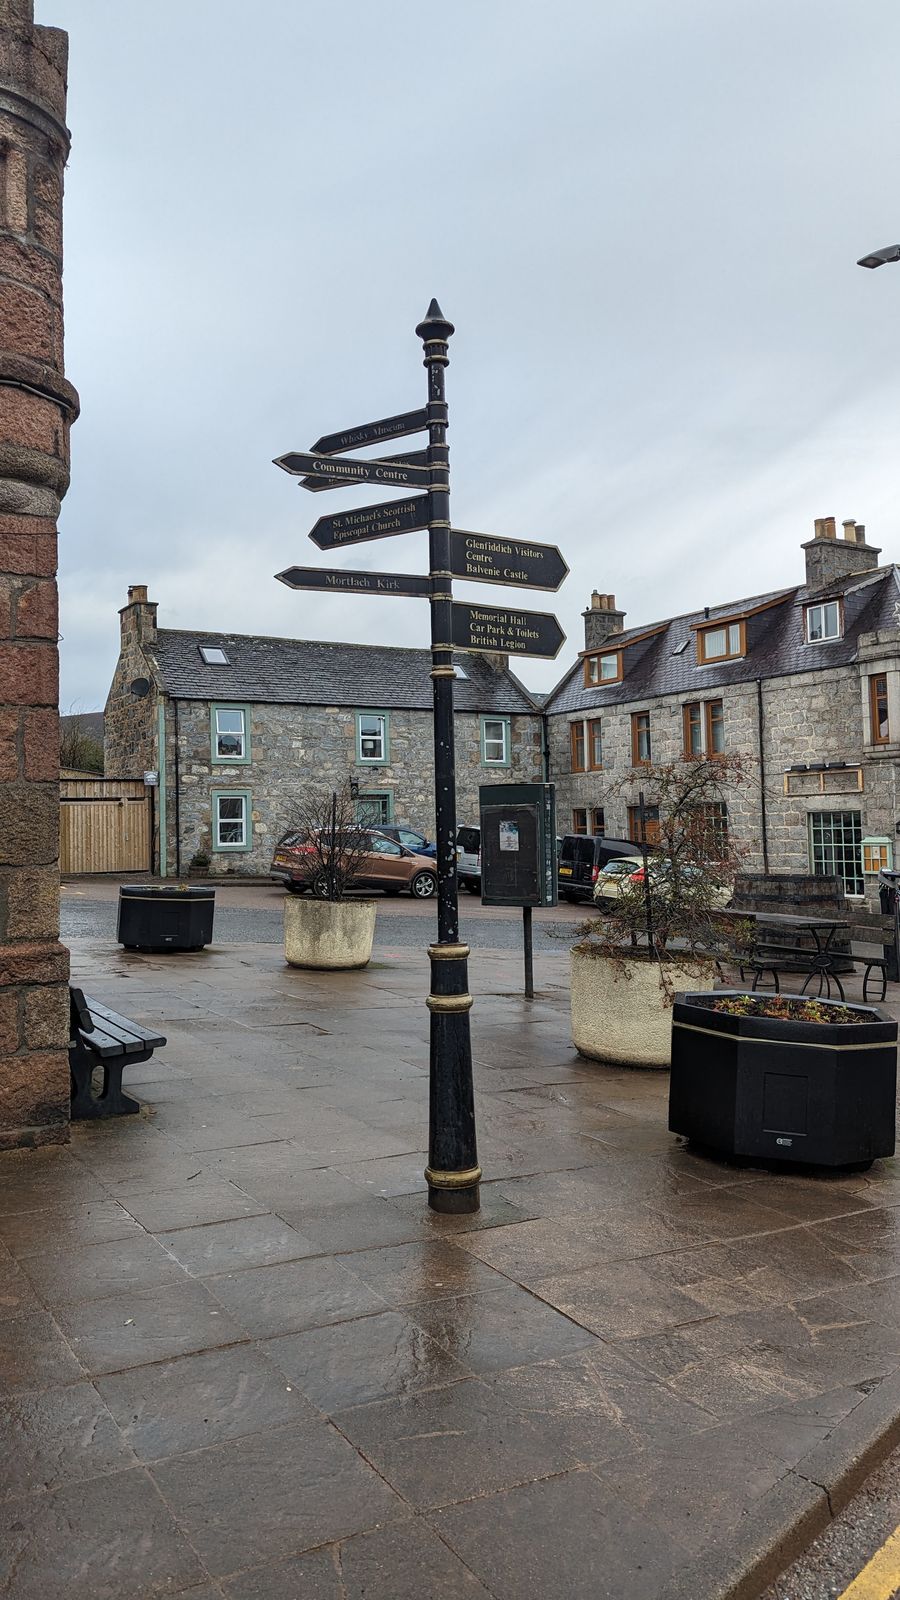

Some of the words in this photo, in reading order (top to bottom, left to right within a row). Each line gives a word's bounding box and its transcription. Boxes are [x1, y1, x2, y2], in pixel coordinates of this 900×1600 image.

[340, 431, 368, 445] Whisky
[373, 423, 405, 436] Museum
[313, 461, 371, 476] Community
[376, 468, 408, 480] Centre
[332, 520, 343, 529] St.
[345, 509, 381, 526] Michael's
[383, 503, 416, 517] Scottish
[333, 525, 369, 540] Episcopal
[372, 519, 400, 531] Church
[466, 539, 512, 554] Glenfiddich
[515, 547, 544, 559] Visitors
[466, 552, 492, 563] Centre
[467, 564, 500, 576] Balvenie
[504, 569, 528, 580] Castle
[326, 575, 370, 587] Mortlach
[377, 579, 400, 589] Kirk
[470, 610, 510, 622] Memorial
[510, 615, 527, 625] Hall
[470, 623, 484, 632] Car
[487, 625, 505, 634] Park
[507, 627, 513, 635] &
[516, 627, 539, 638] Toilets
[471, 635, 497, 646] British
[501, 639, 526, 649] Legion
